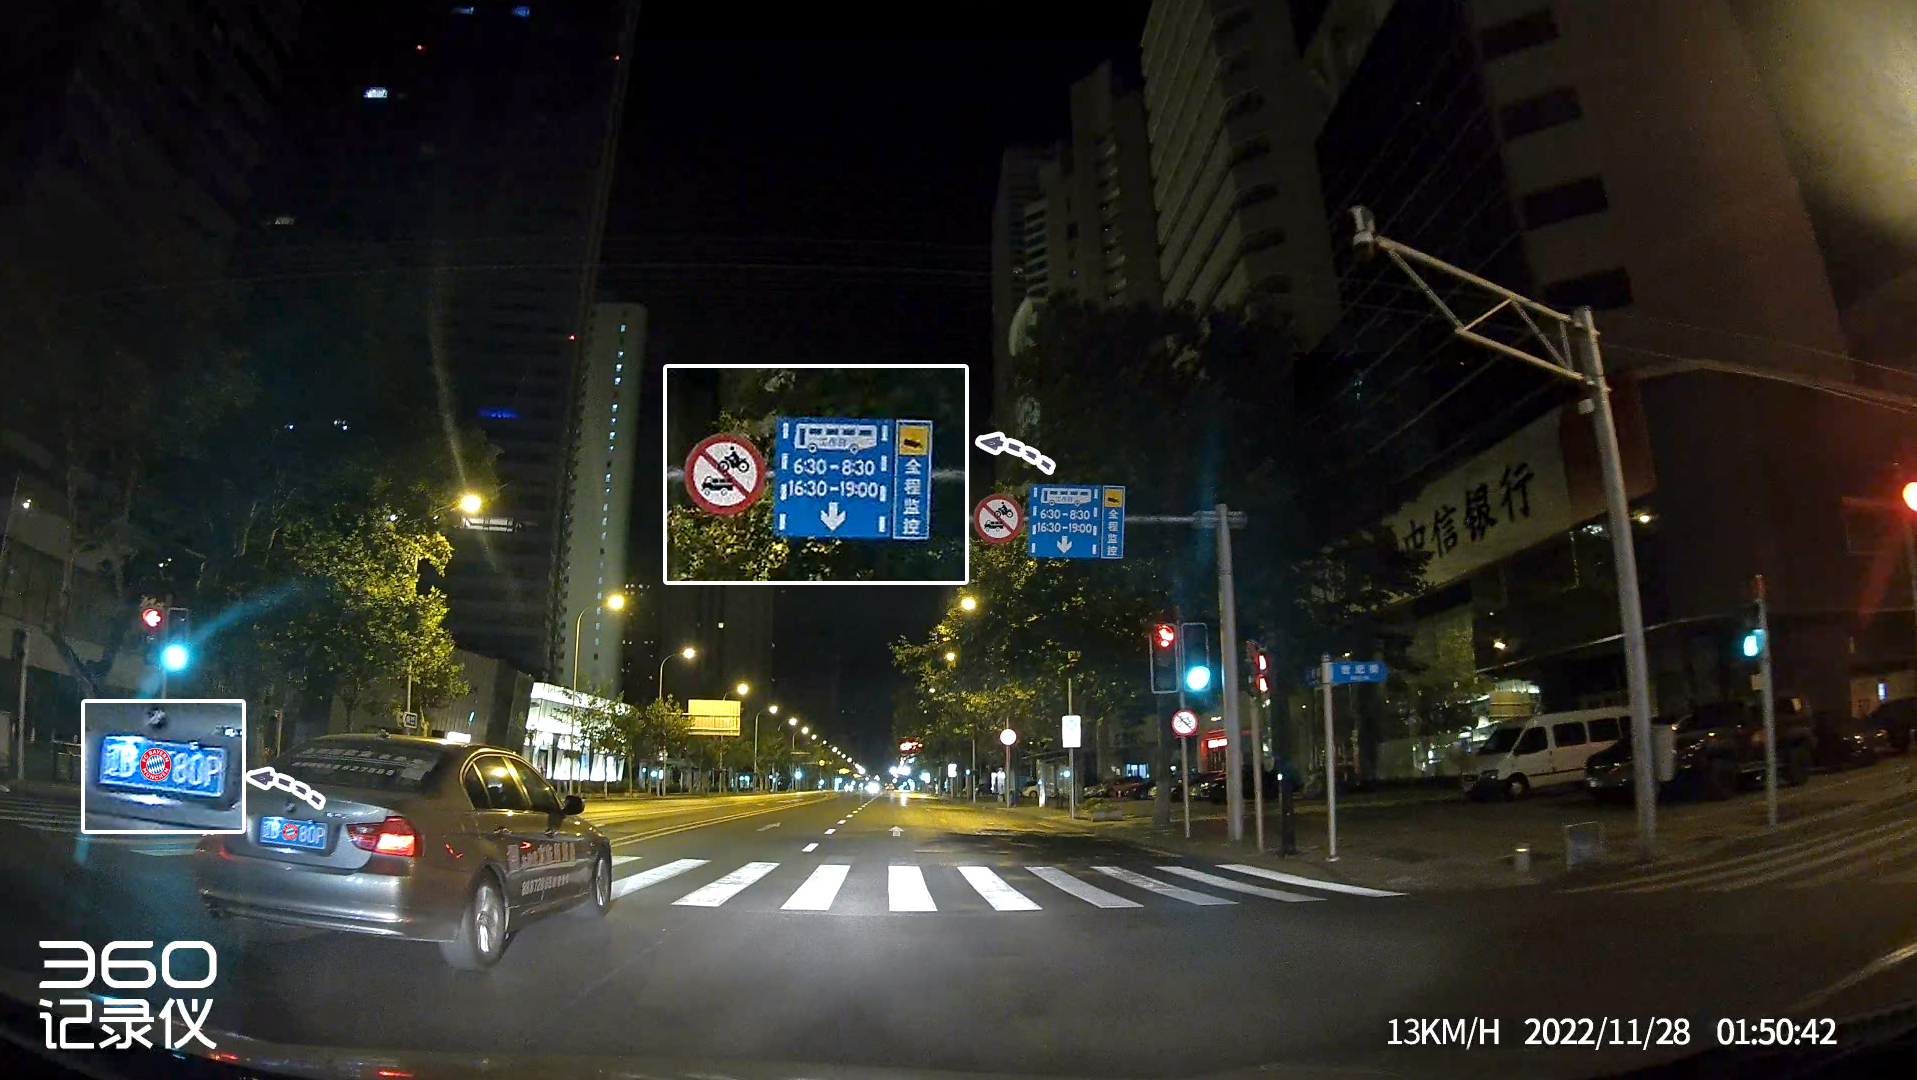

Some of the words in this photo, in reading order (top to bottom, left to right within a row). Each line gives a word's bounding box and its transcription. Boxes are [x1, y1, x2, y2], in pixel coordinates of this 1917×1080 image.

[902, 458, 924, 536] 全程监控
[1106, 509, 1119, 556] 全程监控
